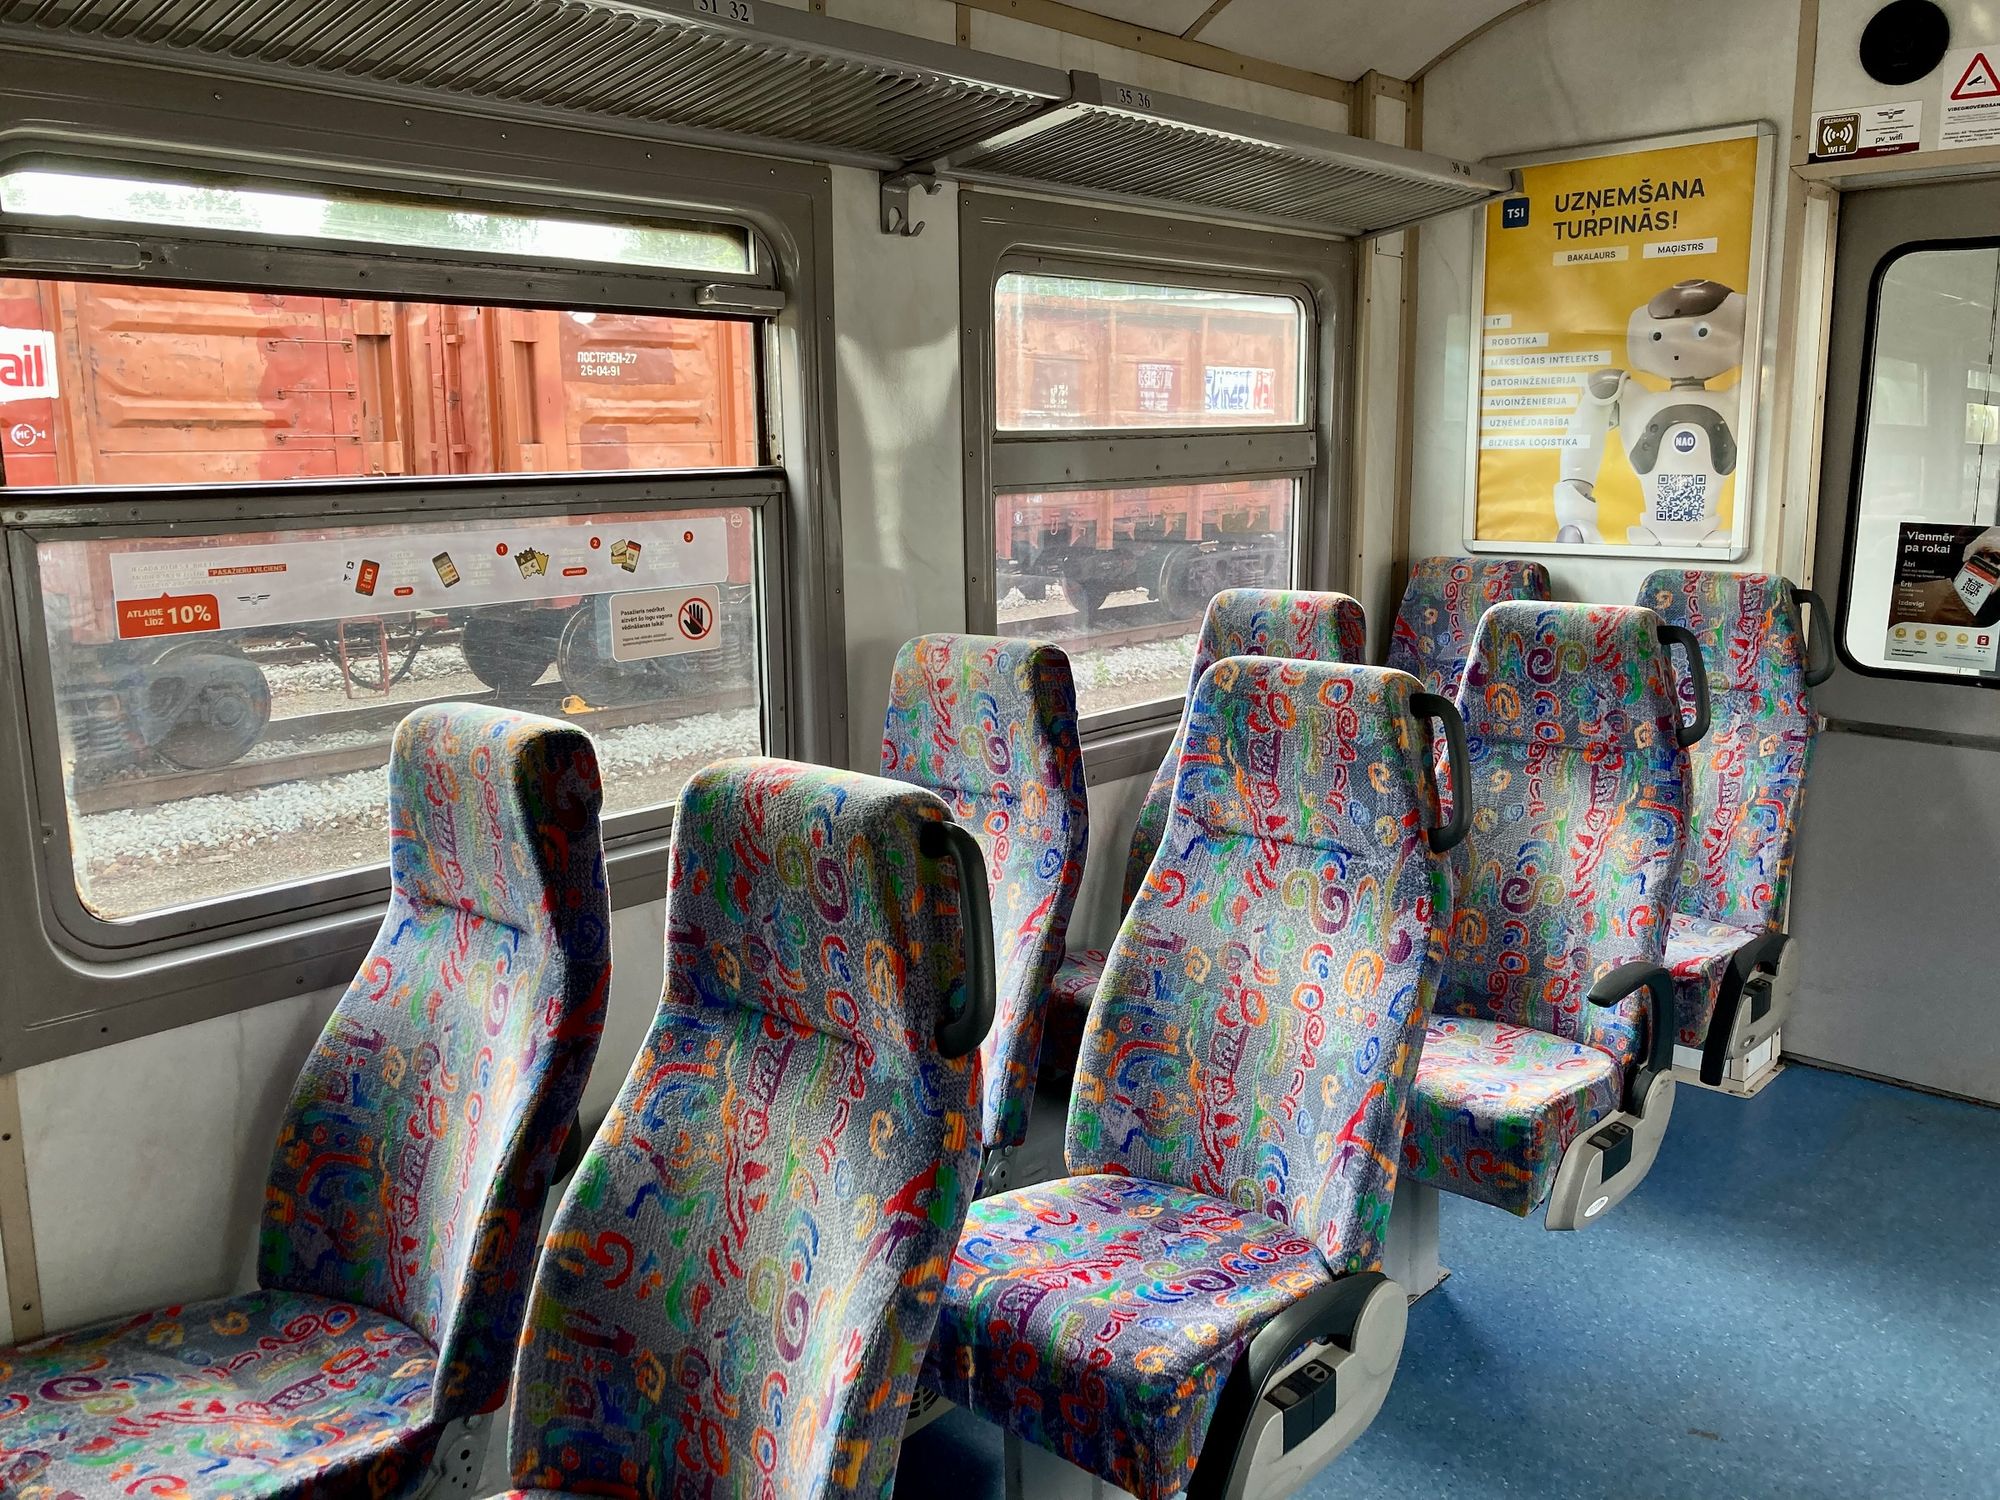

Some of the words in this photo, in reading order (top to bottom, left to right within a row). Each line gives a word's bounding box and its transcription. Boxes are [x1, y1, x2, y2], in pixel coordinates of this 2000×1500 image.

[728, 0, 749, 22] 32
[1119, 88, 1133, 105] 35
[1137, 92, 1151, 109] 36
[1554, 178, 1705, 216] UZŅEMŠANA
[1507, 207, 1525, 219] TSI
[1552, 207, 1678, 240] TURPINĀS!
[1657, 242, 1704, 255] MAĢISTRS
[1567, 250, 1616, 262] BAKALAURS
[1492, 317, 1501, 326] IT
[1491, 336, 1538, 347] ROBOTIKA
[1549, 354, 1600, 364] INTELEKTS
[0, 345, 45, 387] ail
[580, 365, 621, 377] 26-04-91
[1490, 375, 1577, 387] DATORINŽENIERIJA
[1490, 396, 1567, 407] AVIOINŽENIERIJA
[1488, 439, 1526, 448] BIZNESA
[1907, 530, 1955, 543] Vienmēr
[1904, 544, 1920, 554] pa
[1921, 544, 1951, 554] rokai
[127, 608, 163, 619] ATLAIDE
[167, 604, 212, 624] 10%
[144, 617, 165, 627] LĪDZ
